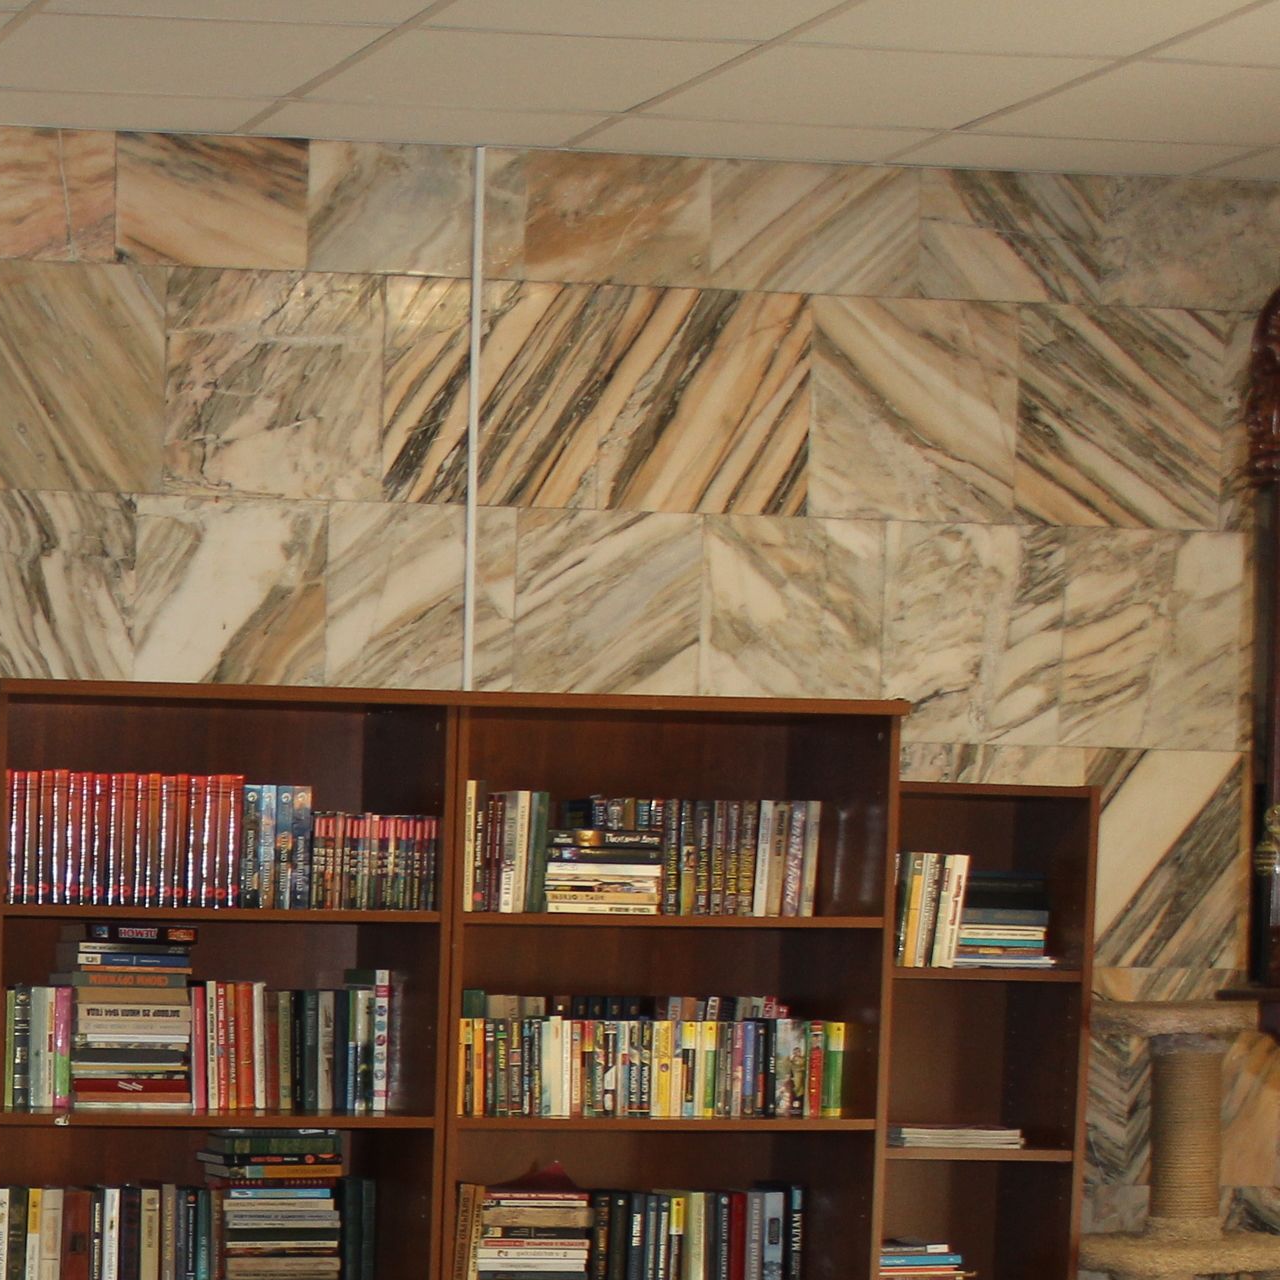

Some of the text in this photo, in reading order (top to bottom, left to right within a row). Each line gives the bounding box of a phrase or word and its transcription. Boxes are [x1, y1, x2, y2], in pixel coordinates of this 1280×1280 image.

[118, 927, 157, 939] ДЕМОН
[86, 1007, 103, 1017] ГОДА
[105, 1008, 119, 1017] 1944
[152, 1008, 180, 1018] ЗАГОВОР
[630, 1065, 638, 1093] СЕРОВА
[641, 1065, 649, 1093] СЕРОВА
